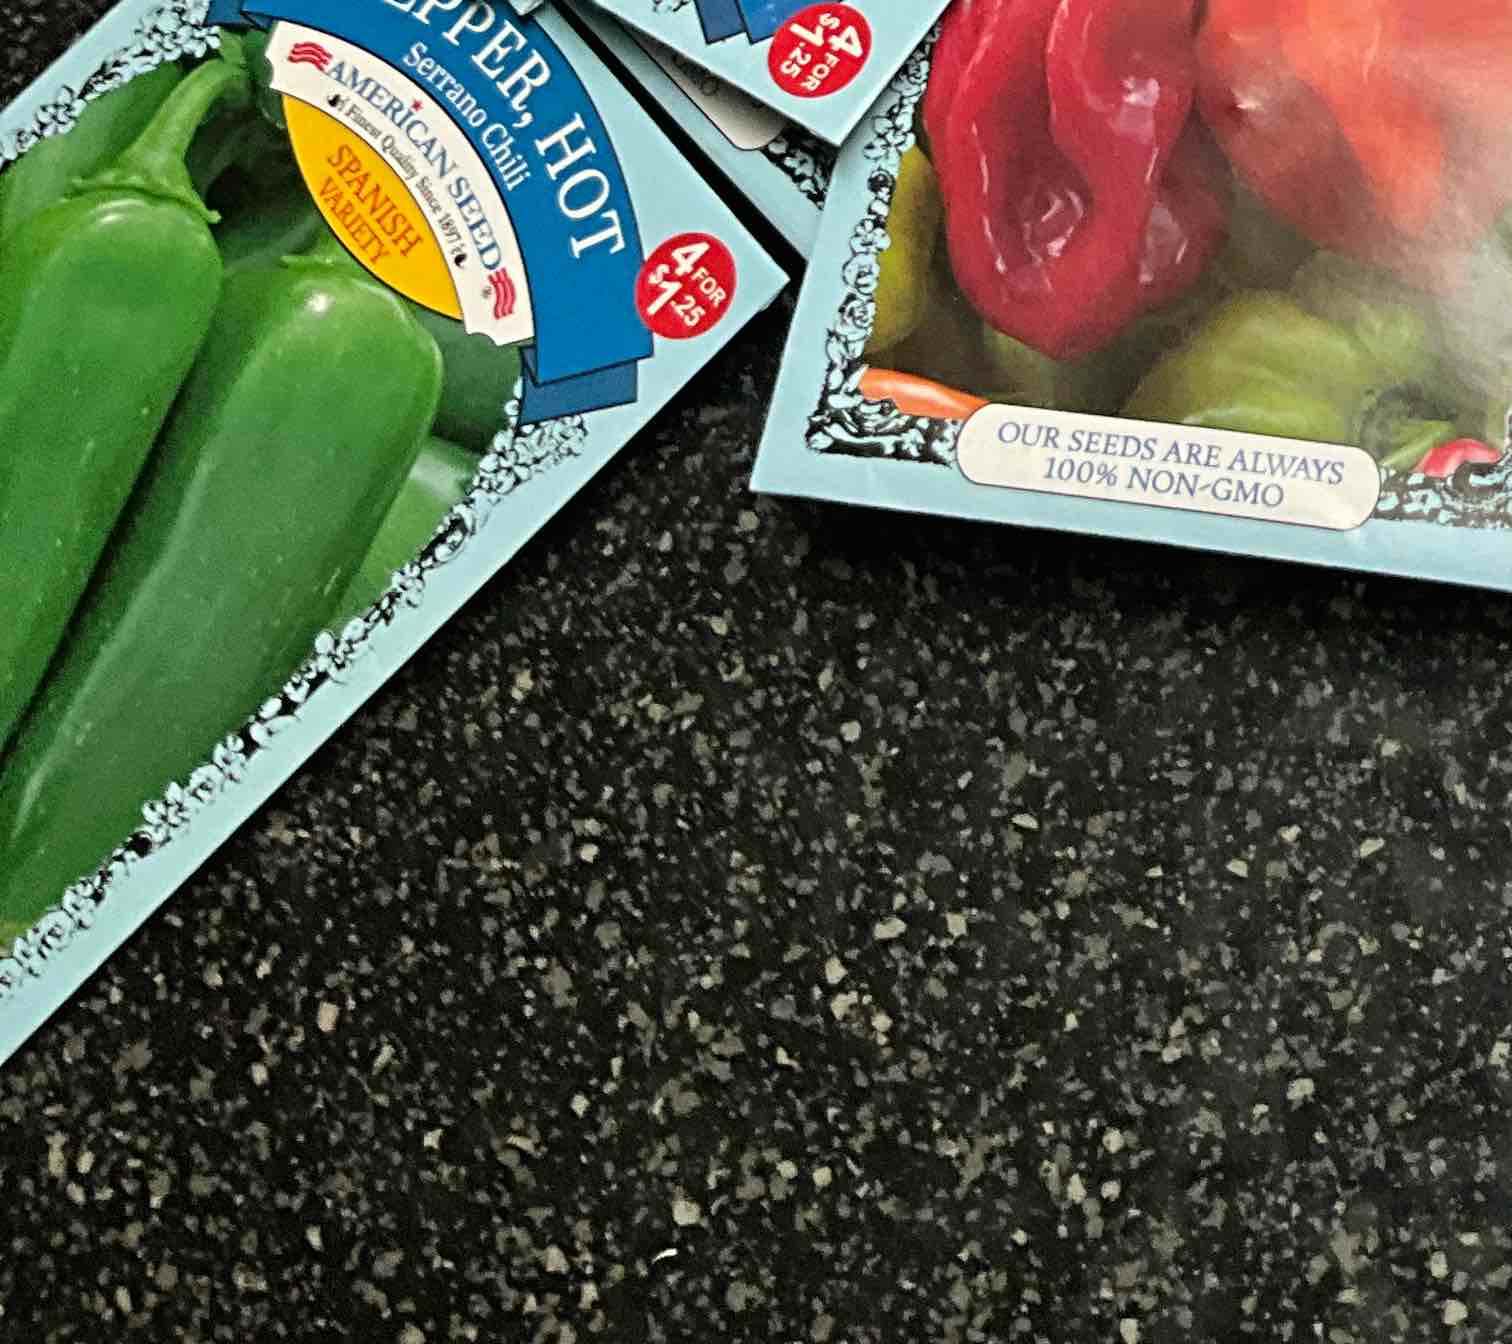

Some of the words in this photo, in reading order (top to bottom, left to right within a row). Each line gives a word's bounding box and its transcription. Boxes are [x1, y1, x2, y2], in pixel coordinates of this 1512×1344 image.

[402, 42, 487, 128] Serrano
[482, 123, 531, 192] Chili
[326, 60, 456, 180] AMERICAN
[446, 178, 503, 272] SEED
[326, 144, 424, 258] SPANISH
[534, 113, 626, 260] HOT
[317, 178, 391, 267] VARIETY
[648, 264, 707, 328] $1.25
[669, 241, 709, 278] 4
[691, 267, 728, 307] FOR
[997, 421, 1059, 448] OUR
[1068, 430, 1157, 461] SEEDS
[1159, 440, 1221, 468] ARE
[1227, 448, 1345, 485] ALWAYS
[1043, 455, 1117, 487] 100%
[1127, 469, 1284, 507] NON-GMO
